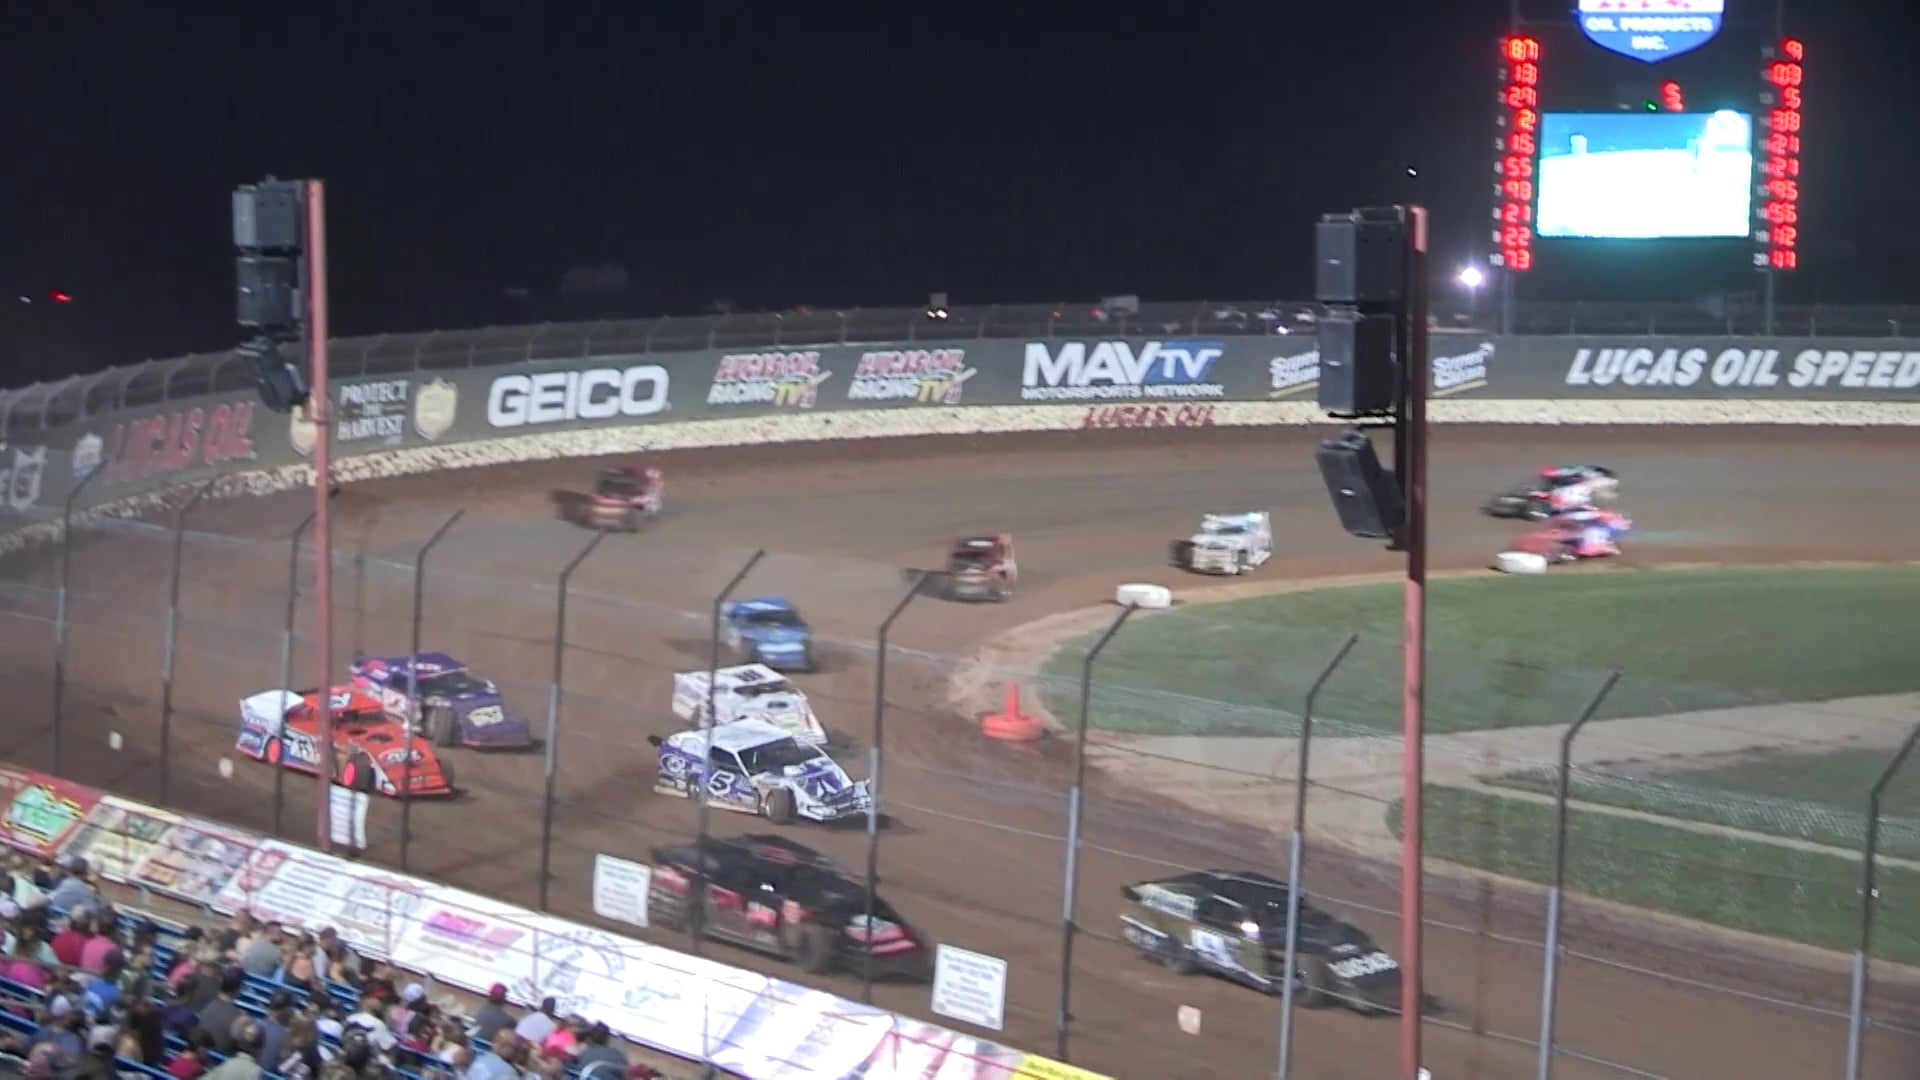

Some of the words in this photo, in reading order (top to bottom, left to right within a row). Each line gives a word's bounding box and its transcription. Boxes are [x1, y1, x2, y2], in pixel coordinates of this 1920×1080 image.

[1586, 16, 1618, 32] OIL
[1620, 16, 1713, 32] PRODUCTS
[1566, 348, 1707, 386] LUCAS
[1711, 348, 1780, 386] OIL
[1787, 349, 1920, 387] SPEED
[487, 365, 670, 427] GEICO
[1021, 385, 1142, 400] MOTORSPORTS
[1144, 383, 1224, 397] NETWORK
[710, 771, 735, 795] 5
